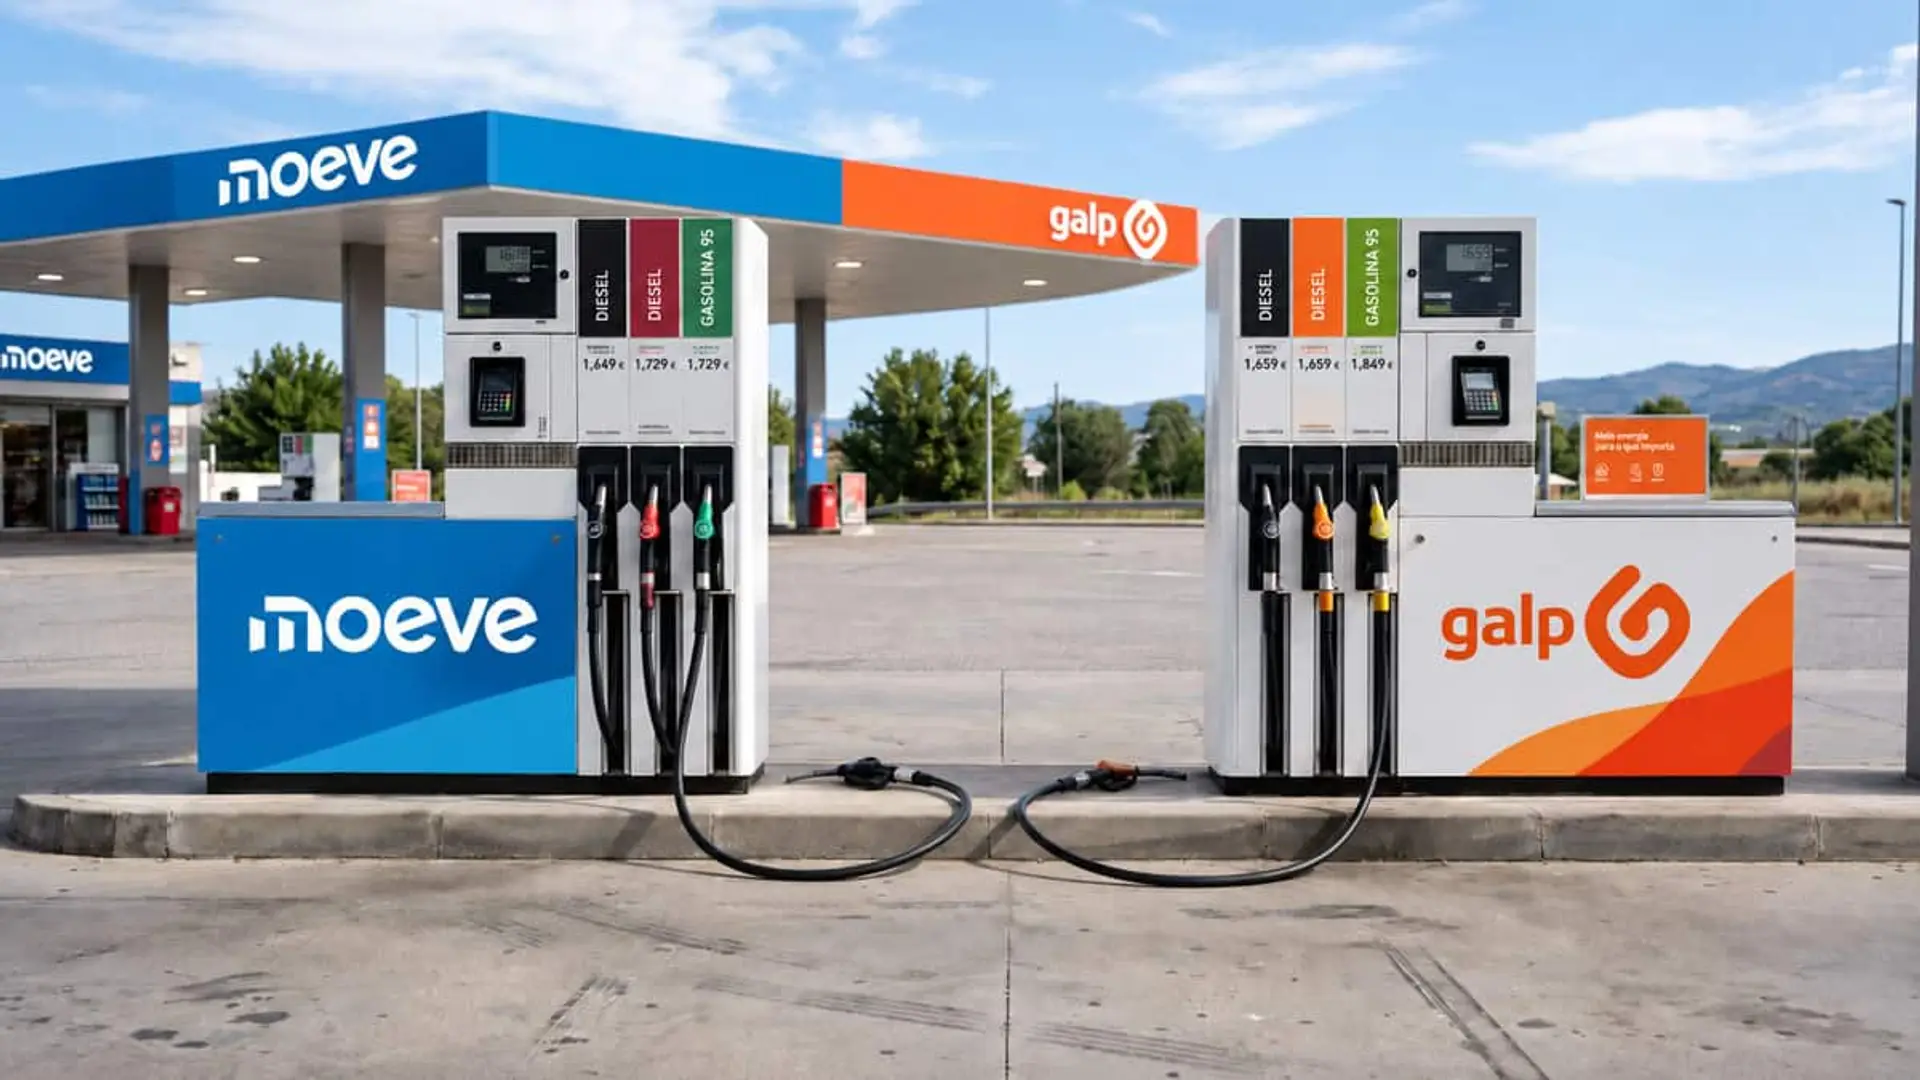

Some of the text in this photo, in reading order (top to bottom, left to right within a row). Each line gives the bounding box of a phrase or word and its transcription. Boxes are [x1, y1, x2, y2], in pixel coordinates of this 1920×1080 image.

[219, 135, 418, 206] moeve
[1050, 201, 1117, 246] galp
[1364, 227, 1380, 246] 95
[595, 269, 610, 322] DIESEL
[647, 268, 662, 322] DIESEL
[700, 228, 715, 327] GASOLINA 95
[1258, 268, 1273, 322] DIESEL
[1310, 267, 1326, 321] DIESEL
[1364, 248, 1380, 327] GASOLINA
[1, 345, 93, 373] moeve
[583, 358, 616, 371] 1,649
[635, 358, 669, 371] 1,729
[688, 358, 722, 371] 1,729
[1244, 358, 1279, 371] 1,659
[1298, 358, 1332, 371] 1,659
[1351, 358, 1386, 371] 1,849
[249, 596, 538, 653] moeve
[1441, 593, 1574, 660] galp
